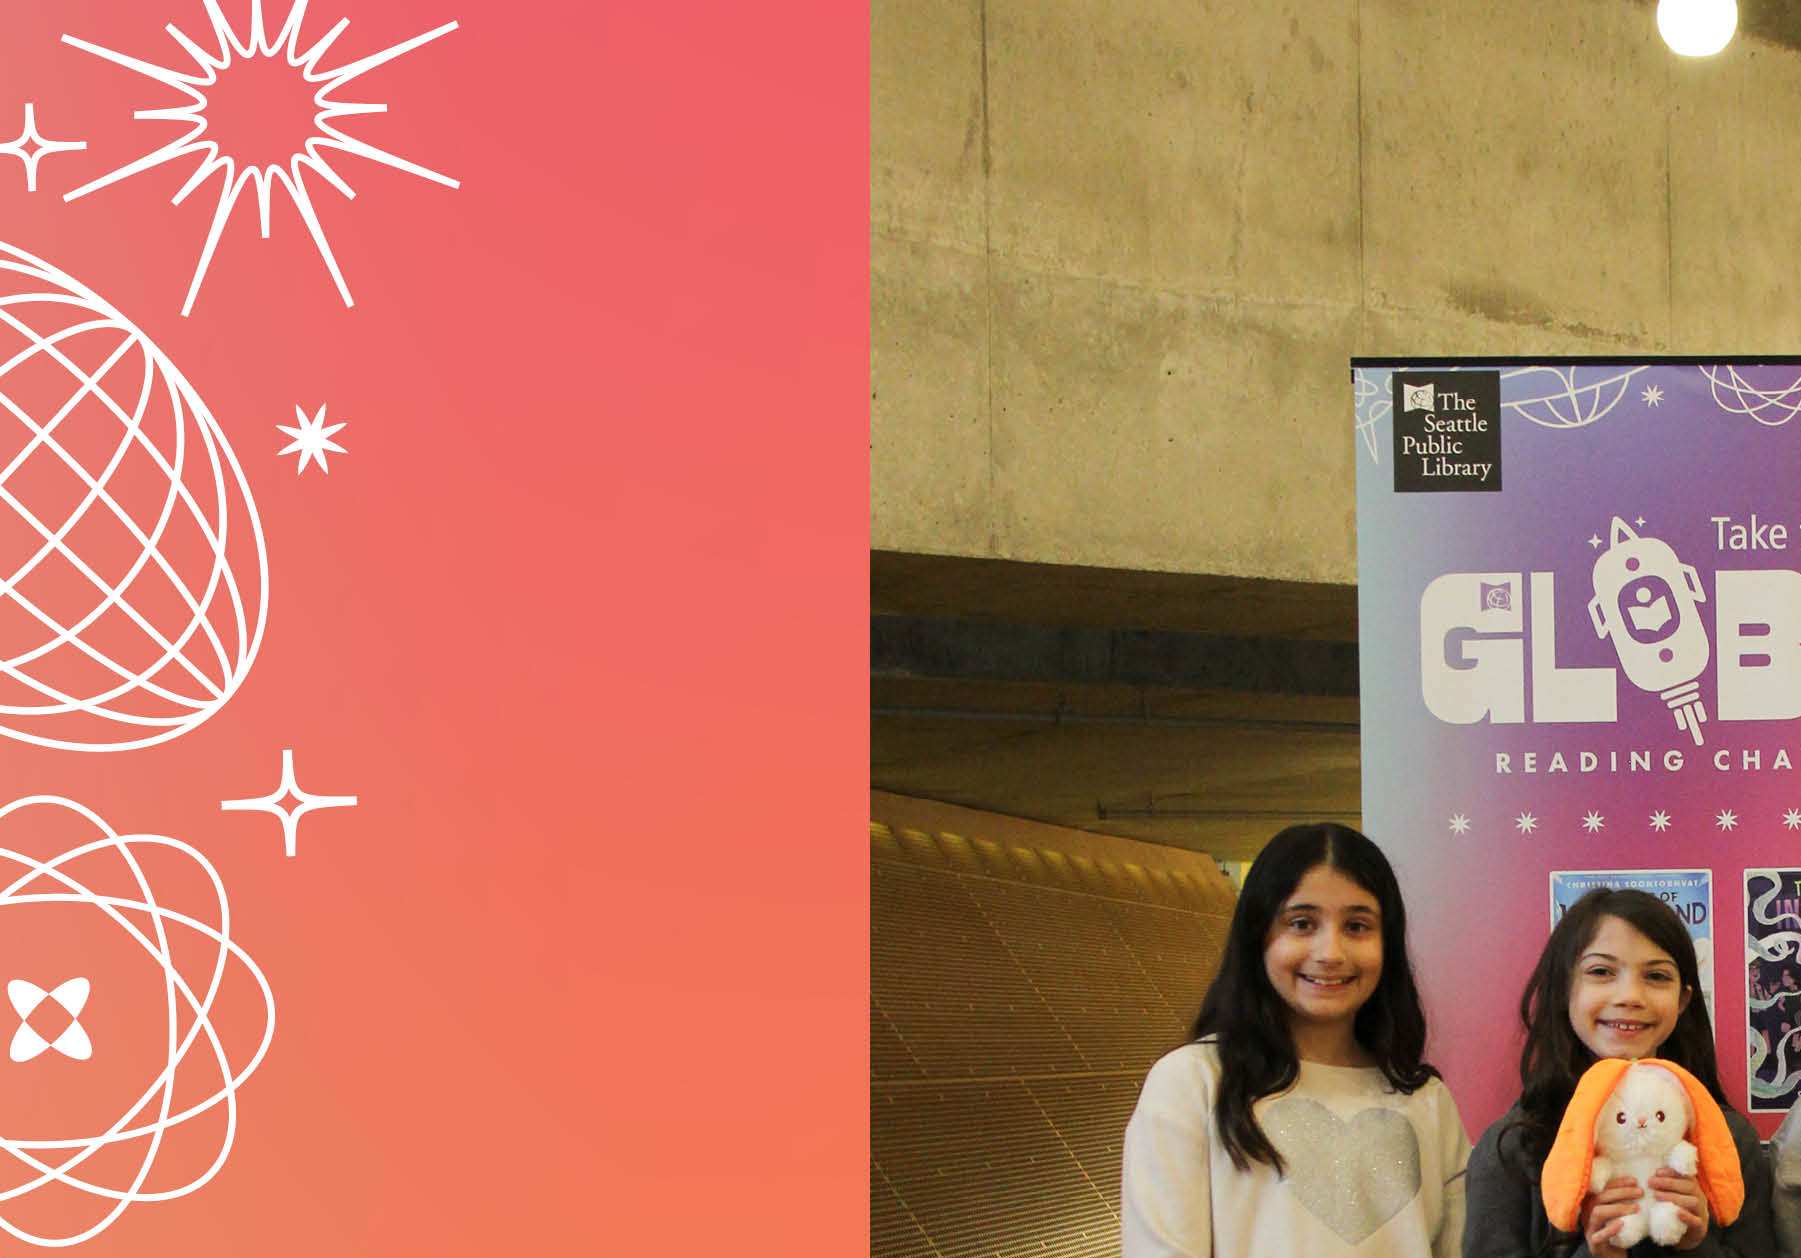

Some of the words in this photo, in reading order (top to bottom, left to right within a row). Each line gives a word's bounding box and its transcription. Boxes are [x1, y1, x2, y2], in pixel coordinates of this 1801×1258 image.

[1437, 392, 1476, 411] The
[1423, 412, 1488, 433] Seattle
[1402, 434, 1463, 455] Public
[1421, 456, 1493, 482] Library
[1711, 514, 1788, 550] Take
[1496, 750, 1685, 773] READING
[1659, 891, 1678, 903] OF
